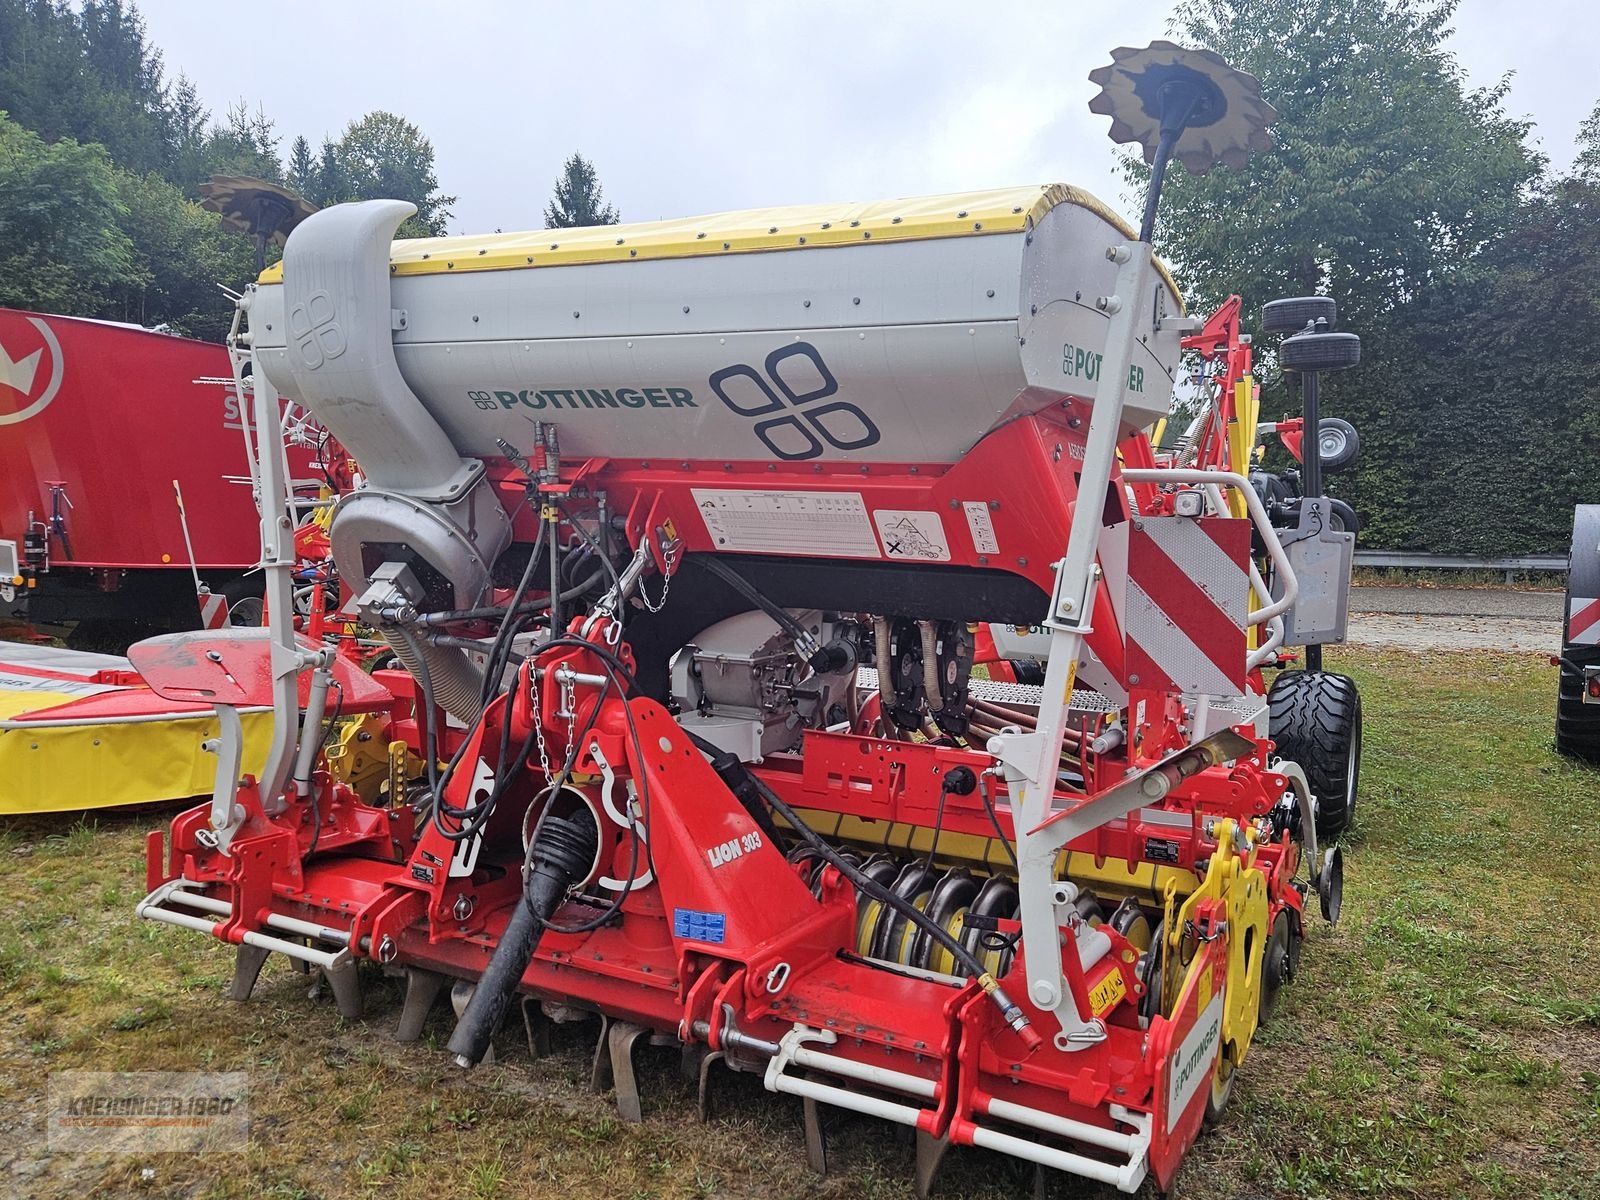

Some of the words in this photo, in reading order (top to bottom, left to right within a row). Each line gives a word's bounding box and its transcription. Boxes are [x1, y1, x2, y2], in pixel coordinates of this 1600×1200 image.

[494, 387, 699, 410] PÖTTINGER
[707, 838, 743, 868] LION
[741, 831, 762, 853] 303
